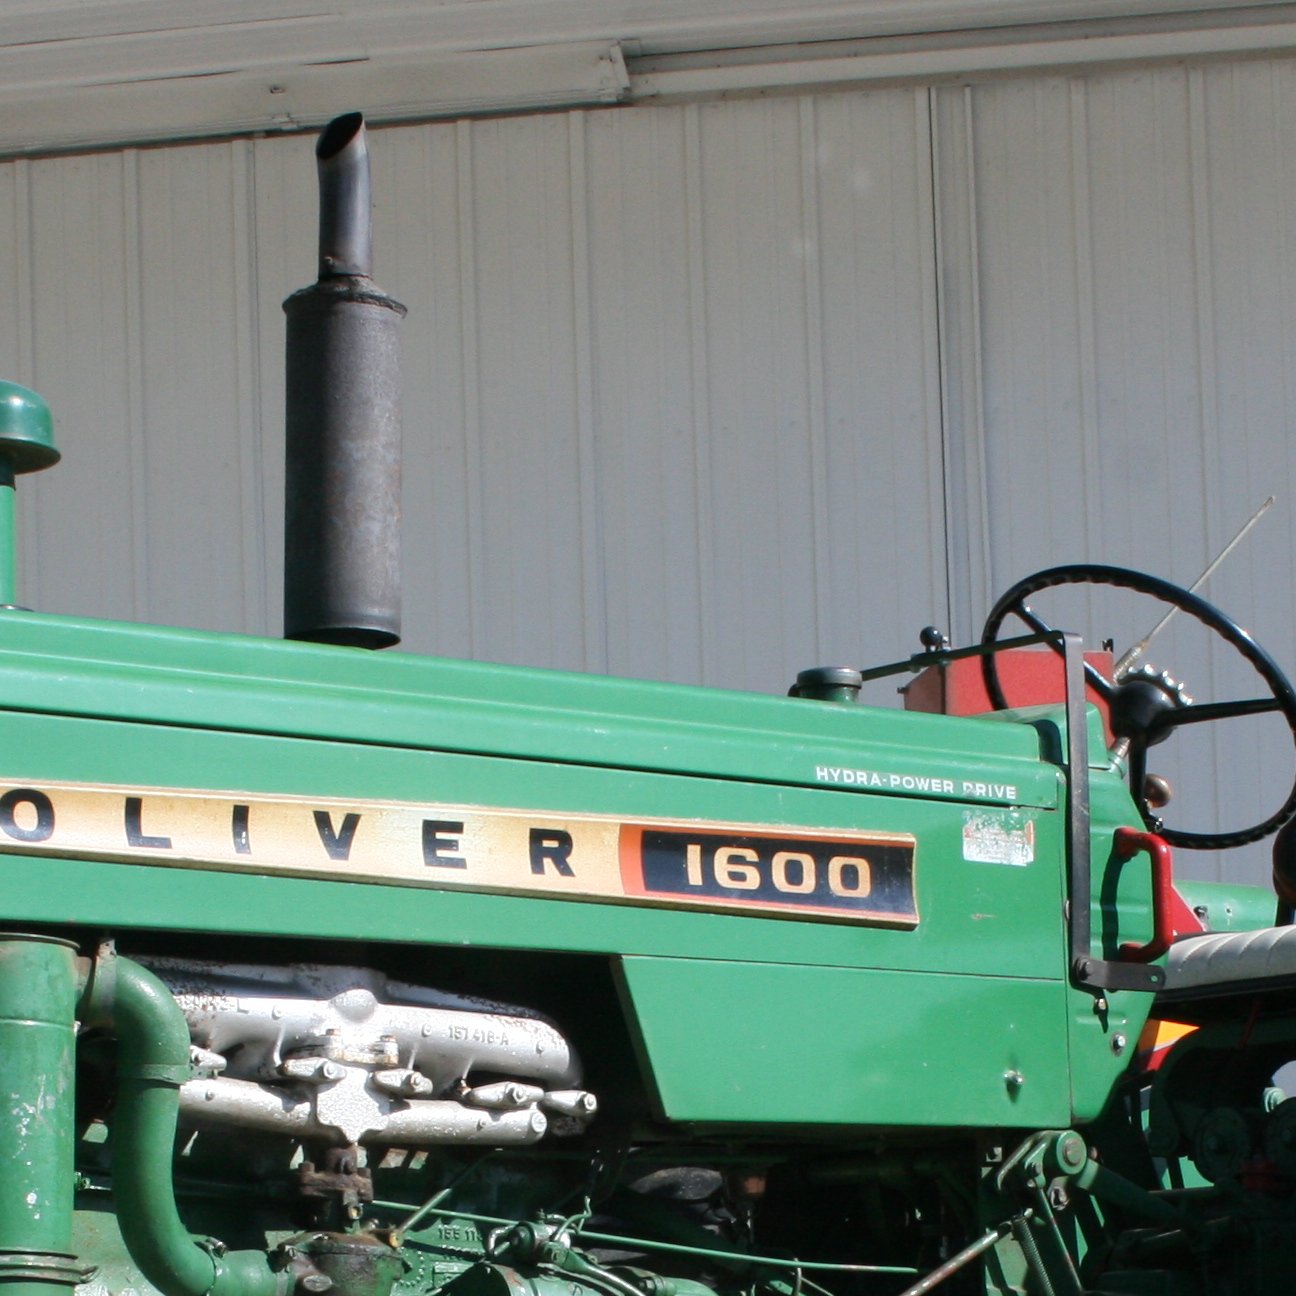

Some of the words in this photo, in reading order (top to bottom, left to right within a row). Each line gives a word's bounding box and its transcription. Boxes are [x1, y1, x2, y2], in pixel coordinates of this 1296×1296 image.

[815, 766, 954, 793] HYDRA-POWER
[961, 782, 1017, 800] DRIVE
[686, 843, 873, 898] 1600
